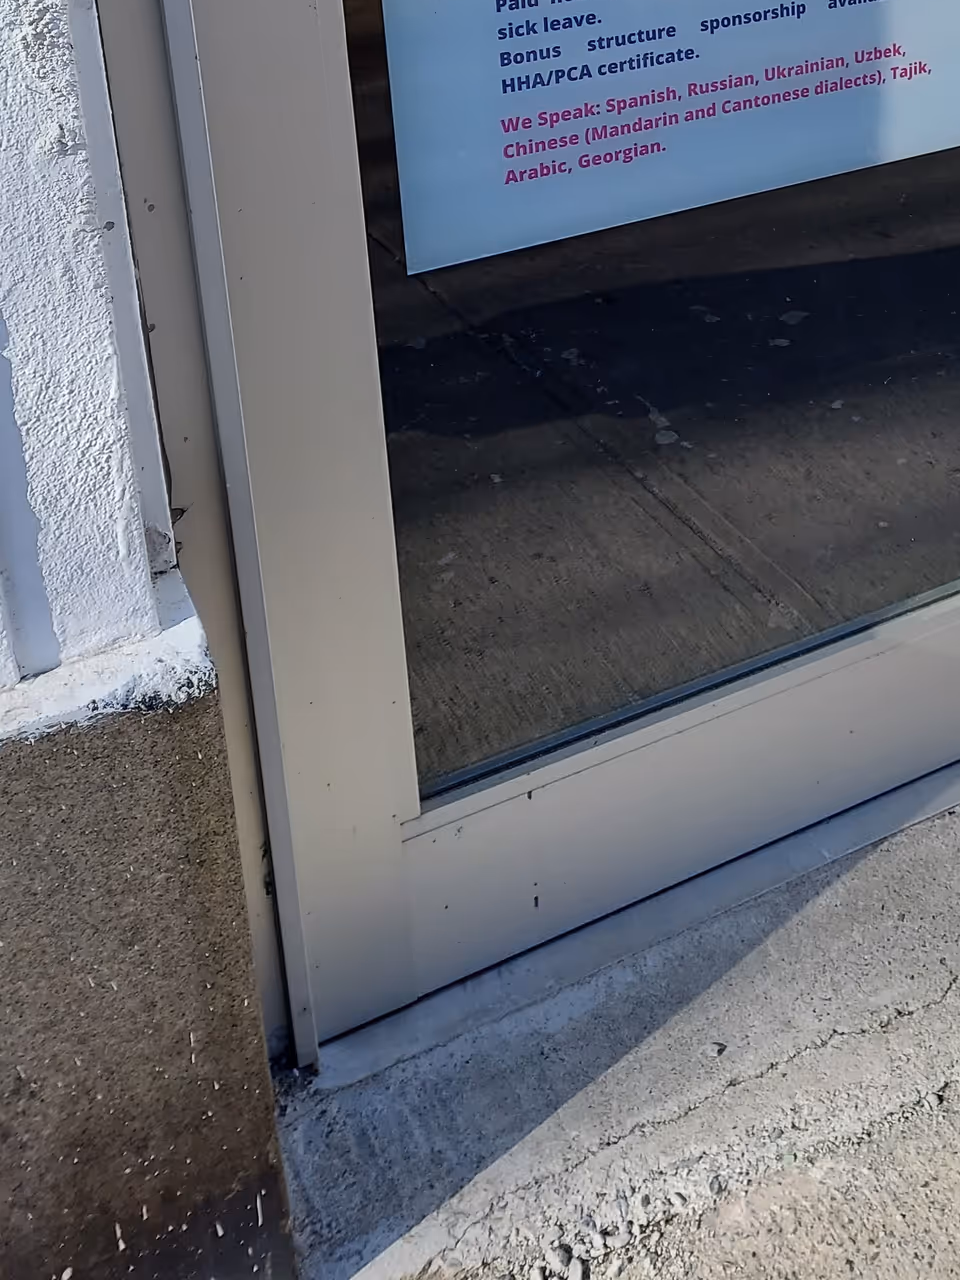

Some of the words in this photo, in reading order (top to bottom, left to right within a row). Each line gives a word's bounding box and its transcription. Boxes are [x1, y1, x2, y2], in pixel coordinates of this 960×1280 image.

[498, 20, 538, 40] sick
[543, 13, 602, 32] leave.
[500, 46, 561, 67] Bonus
[588, 26, 676, 51] structure
[700, 1, 806, 34] sponsorship
[500, 117, 532, 133] We
[538, 103, 600, 128] Speak:
[606, 87, 681, 115] Spanish,
[688, 75, 759, 97] Russian,
[763, 55, 851, 83] Ukrainian,
[855, 43, 906, 63] Uzbek,
[502, 64, 592, 94] HHA/PCA
[598, 49, 699, 76] certificate.
[503, 134, 579, 159] Chinese
[585, 112, 679, 145] (Mandarin
[684, 102, 716, 122] and
[722, 88, 809, 114] Cantonese
[815, 70, 886, 95] dialects),
[890, 61, 931, 80] Tajik,
[504, 160, 572, 185] Arabic,
[578, 142, 666, 168] Georgian.
